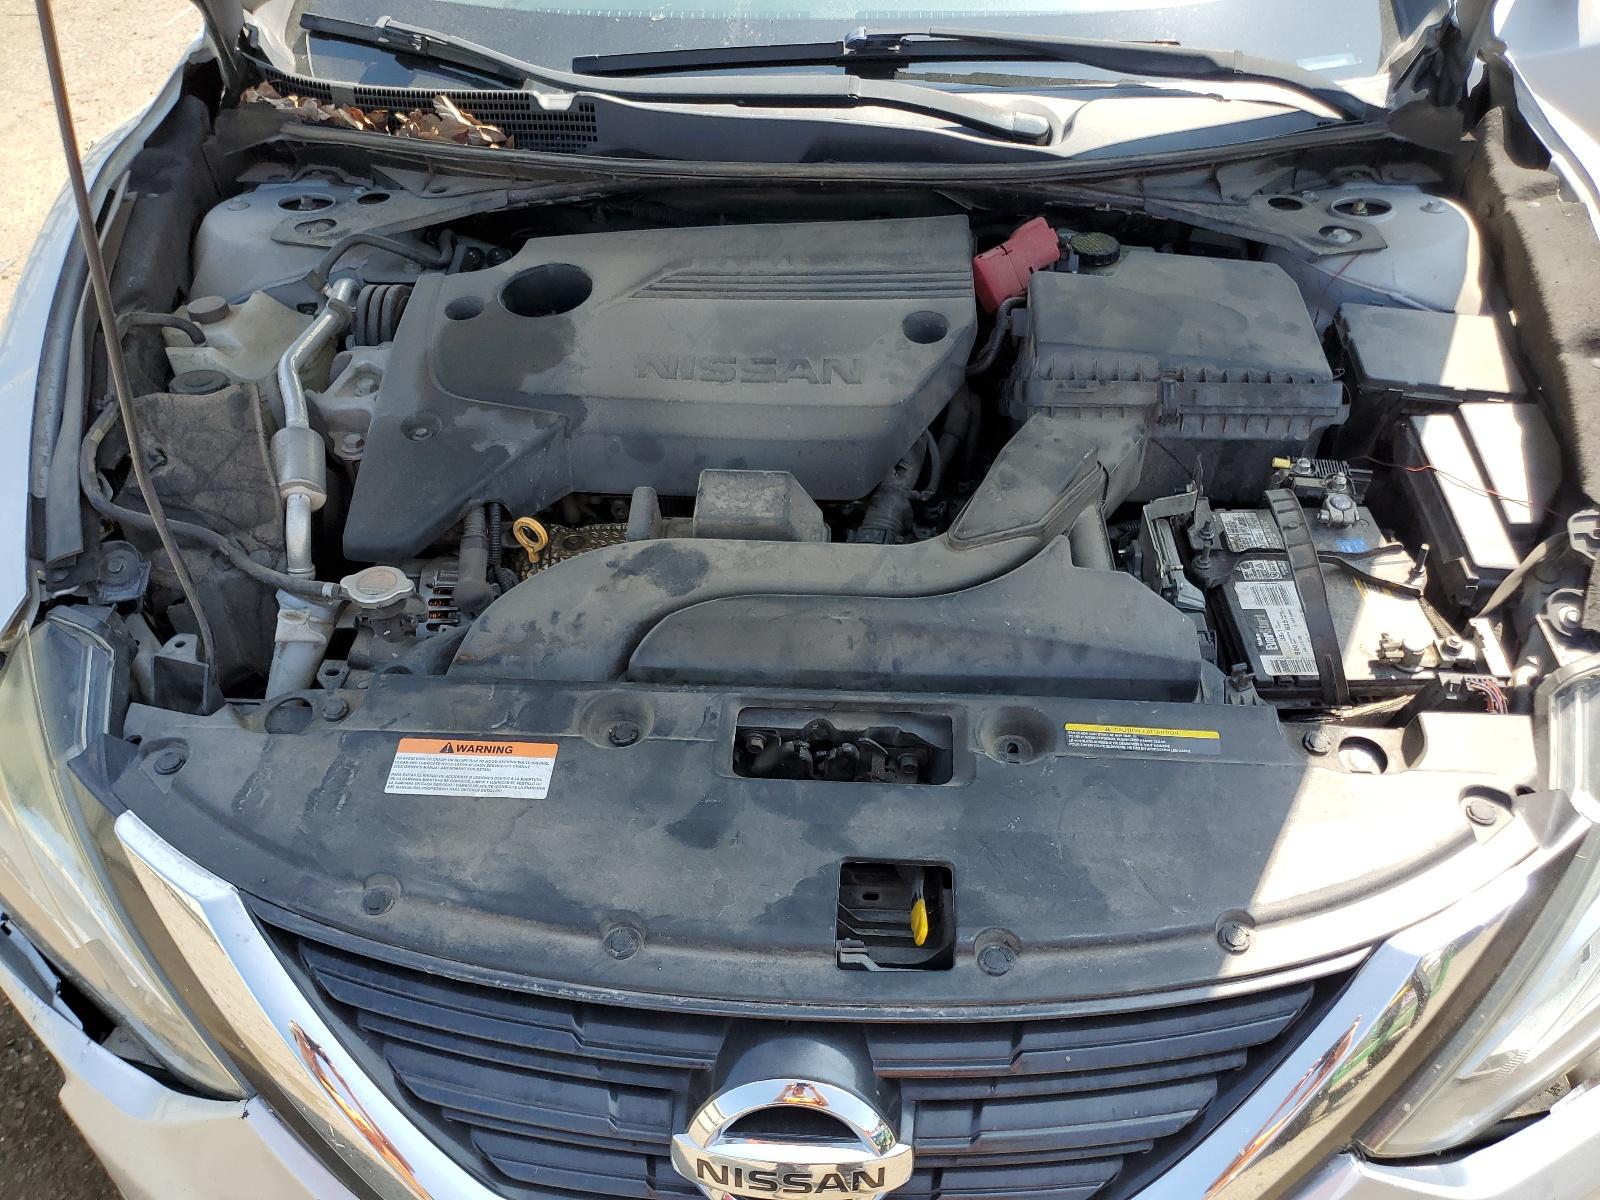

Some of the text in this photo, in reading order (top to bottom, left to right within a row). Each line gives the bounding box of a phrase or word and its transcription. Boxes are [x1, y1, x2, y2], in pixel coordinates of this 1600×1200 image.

[636, 353, 863, 385] NISSAN
[456, 744, 514, 754] WARNING
[696, 1158, 886, 1194] NISSAN
